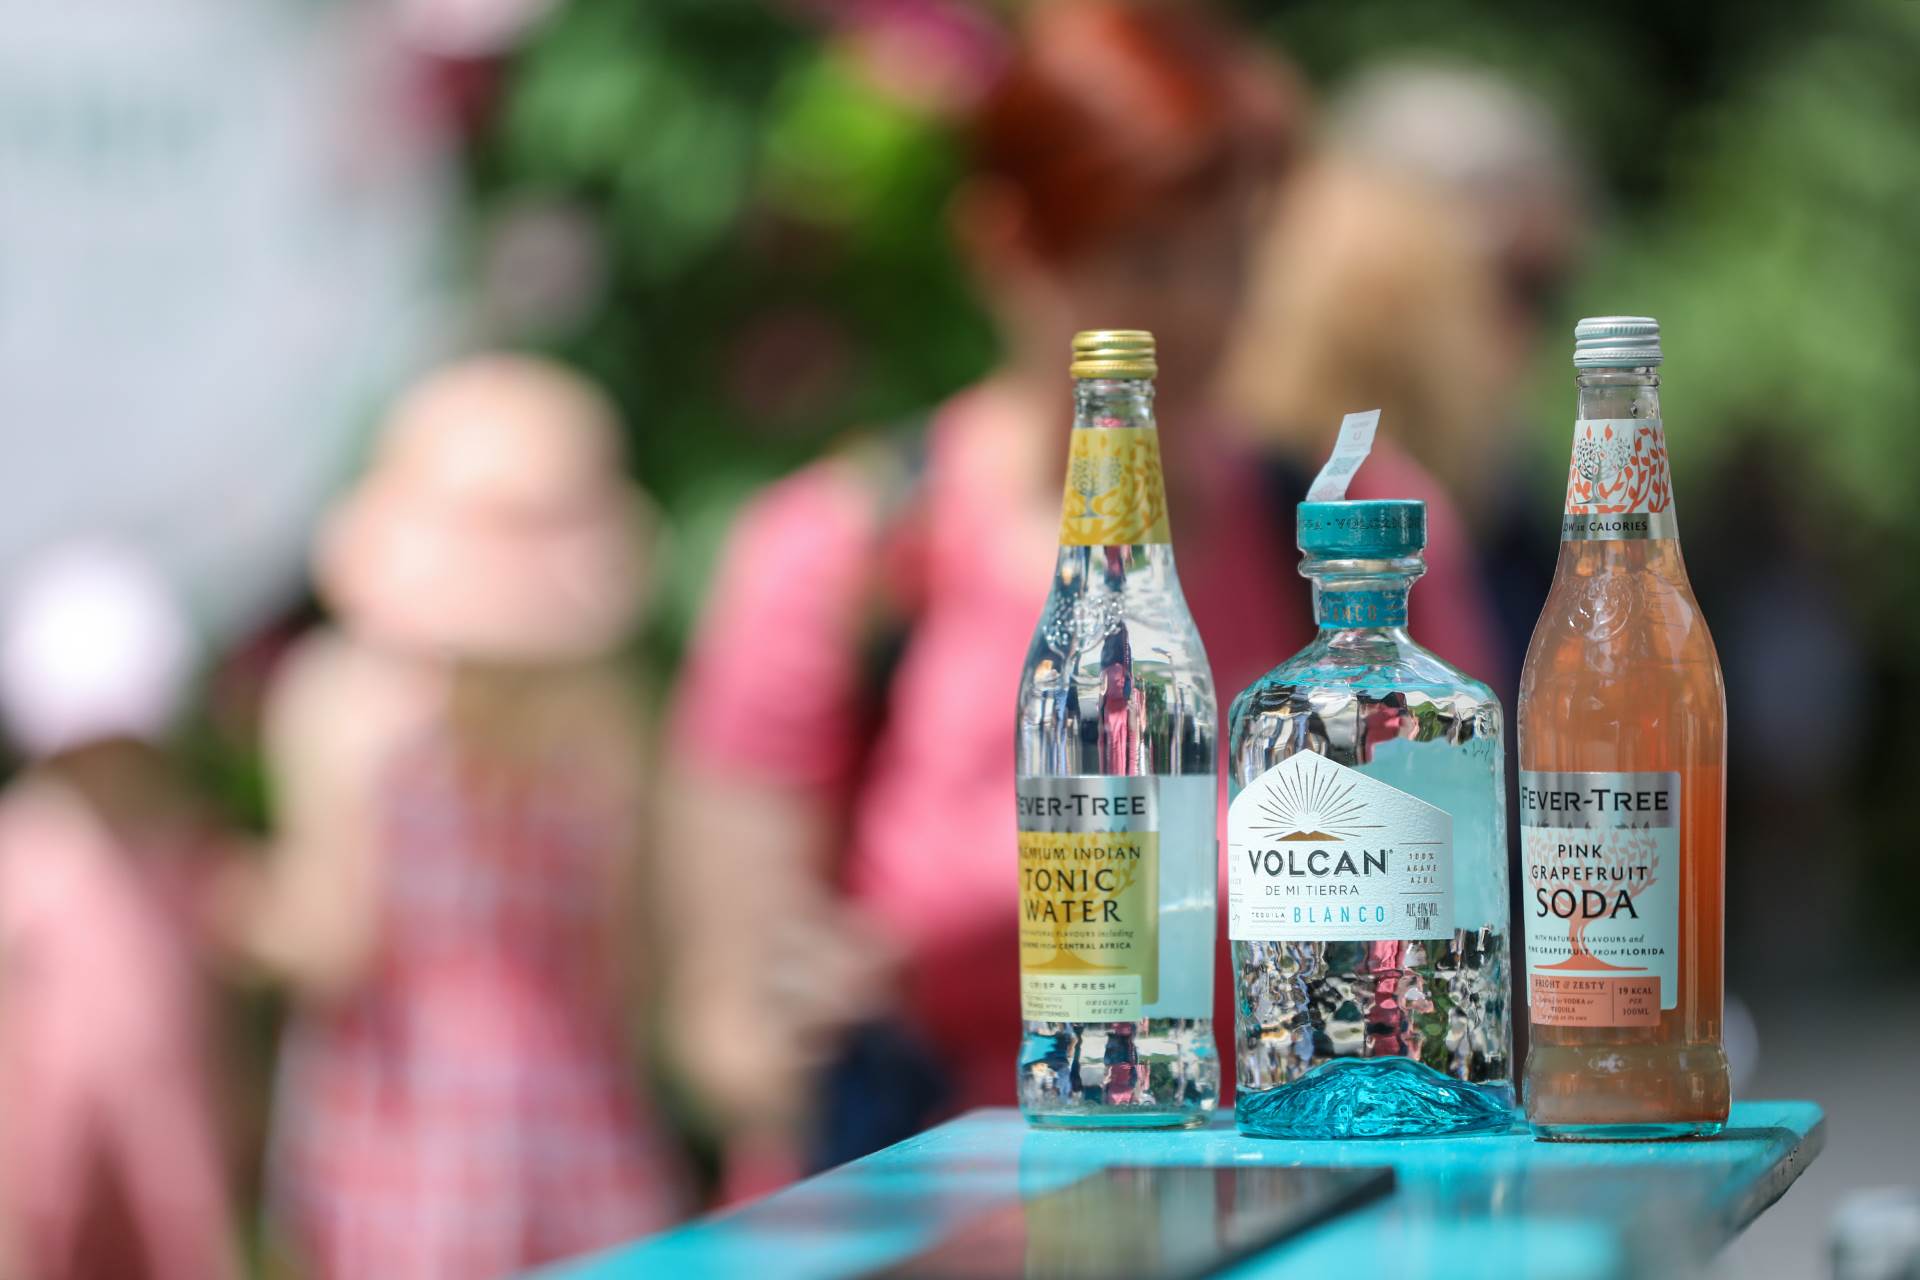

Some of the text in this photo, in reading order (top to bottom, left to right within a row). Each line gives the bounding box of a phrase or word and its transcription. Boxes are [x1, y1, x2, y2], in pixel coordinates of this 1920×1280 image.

[1563, 522, 1575, 532] OW
[1589, 521, 1648, 531] CALORIES
[1016, 792, 1146, 817] EVER-TREE
[1521, 786, 1669, 812] FEVER-TREE
[1073, 846, 1141, 860] INDIAN
[1409, 852, 1434, 860] 100%
[1557, 843, 1603, 859] PINK
[1248, 849, 1389, 877] VOLCAN
[1407, 864, 1437, 872] AGAVE
[1531, 864, 1648, 881] GRAPEFRUIT
[1024, 868, 1115, 892] TONIC
[1410, 876, 1434, 884] AZUL
[1265, 884, 1359, 896] DE MI TIERRA
[1536, 887, 1639, 919] SODA
[1024, 900, 1122, 923] WATER
[1293, 905, 1385, 923] BLANCO
[1548, 935, 1579, 943] NATURAL
[1582, 935, 1626, 943] FLAVOURS
[1628, 934, 1645, 943] and
[1099, 942, 1132, 950] AFRICA
[1539, 946, 1590, 956] GRAPEFRUIT
[1620, 947, 1665, 956] FLORIDA
[1573, 981, 1605, 990] ZESTY
[1618, 986, 1653, 995] 19 KCAL
[1622, 1008, 1649, 1016] 100ML
